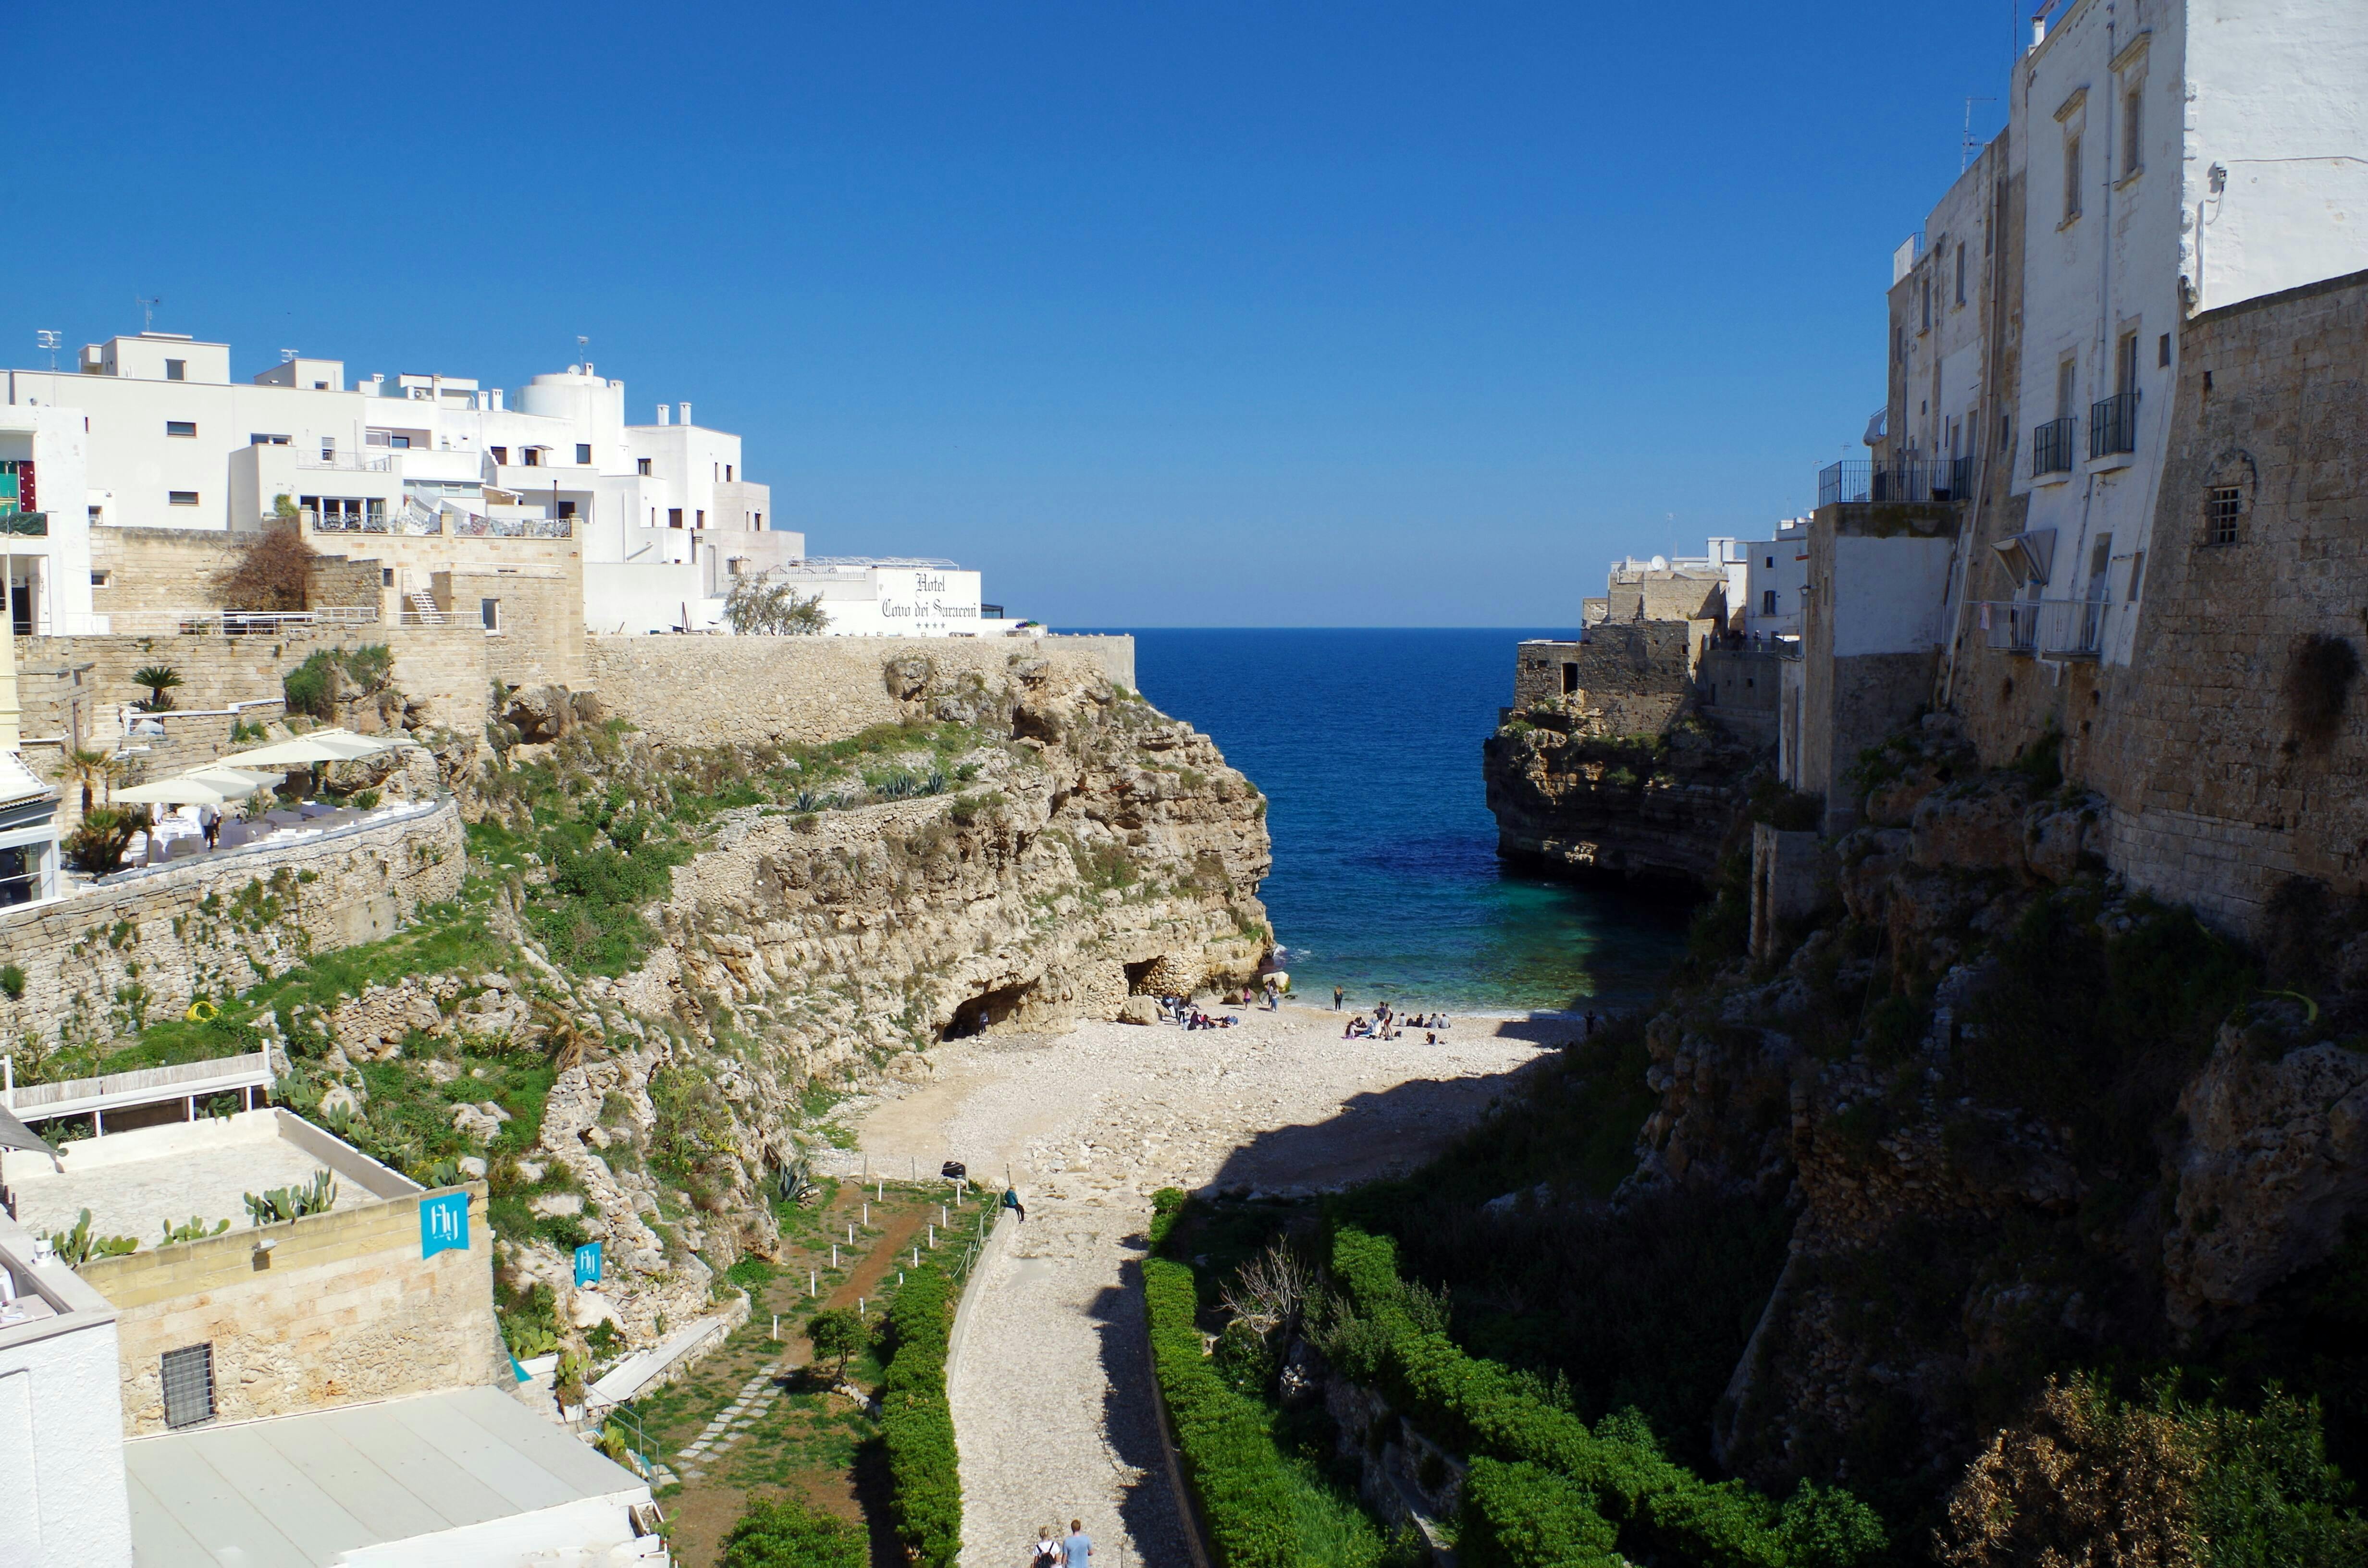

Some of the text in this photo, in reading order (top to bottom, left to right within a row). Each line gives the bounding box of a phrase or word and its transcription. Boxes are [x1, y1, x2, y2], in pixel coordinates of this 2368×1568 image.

[915, 573, 946, 598] Hotel
[882, 598, 976, 618] Covo dei Saraceni
